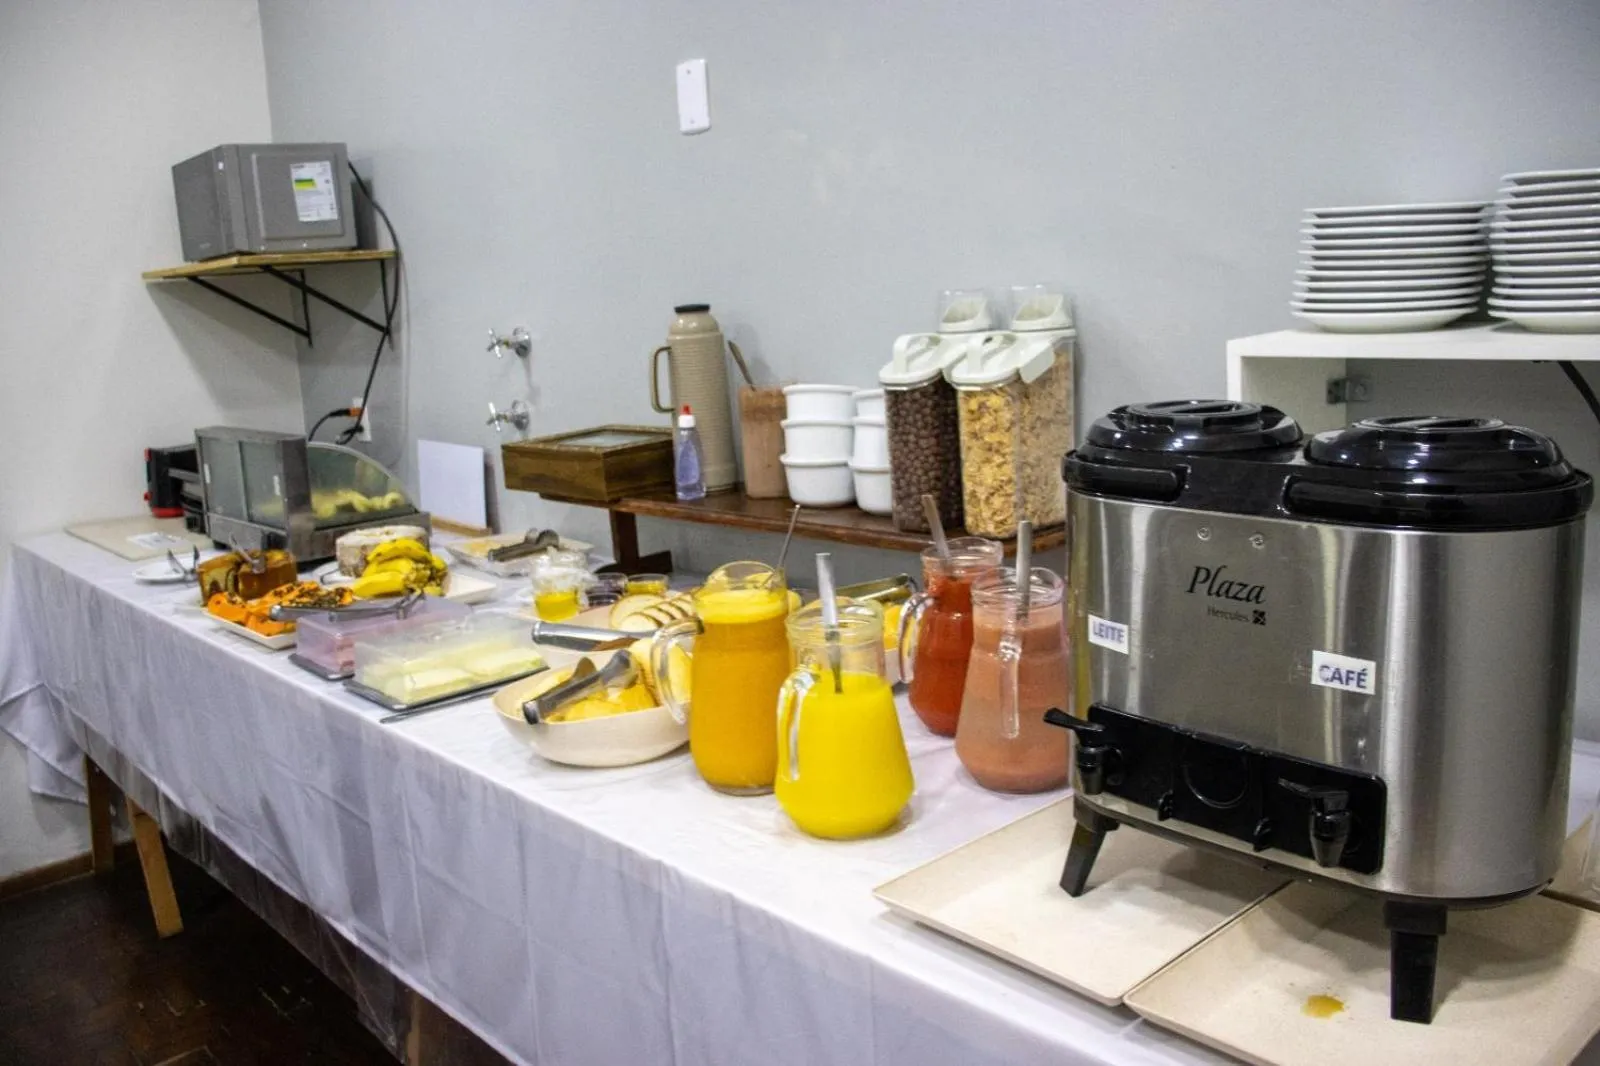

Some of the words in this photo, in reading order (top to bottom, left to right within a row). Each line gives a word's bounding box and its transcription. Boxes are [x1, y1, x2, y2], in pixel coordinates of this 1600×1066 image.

[1186, 565, 1267, 604] Plaza
[1207, 605, 1250, 622] Hercules
[1092, 620, 1125, 644] LEITE
[1319, 664, 1368, 689] CAFÉ
